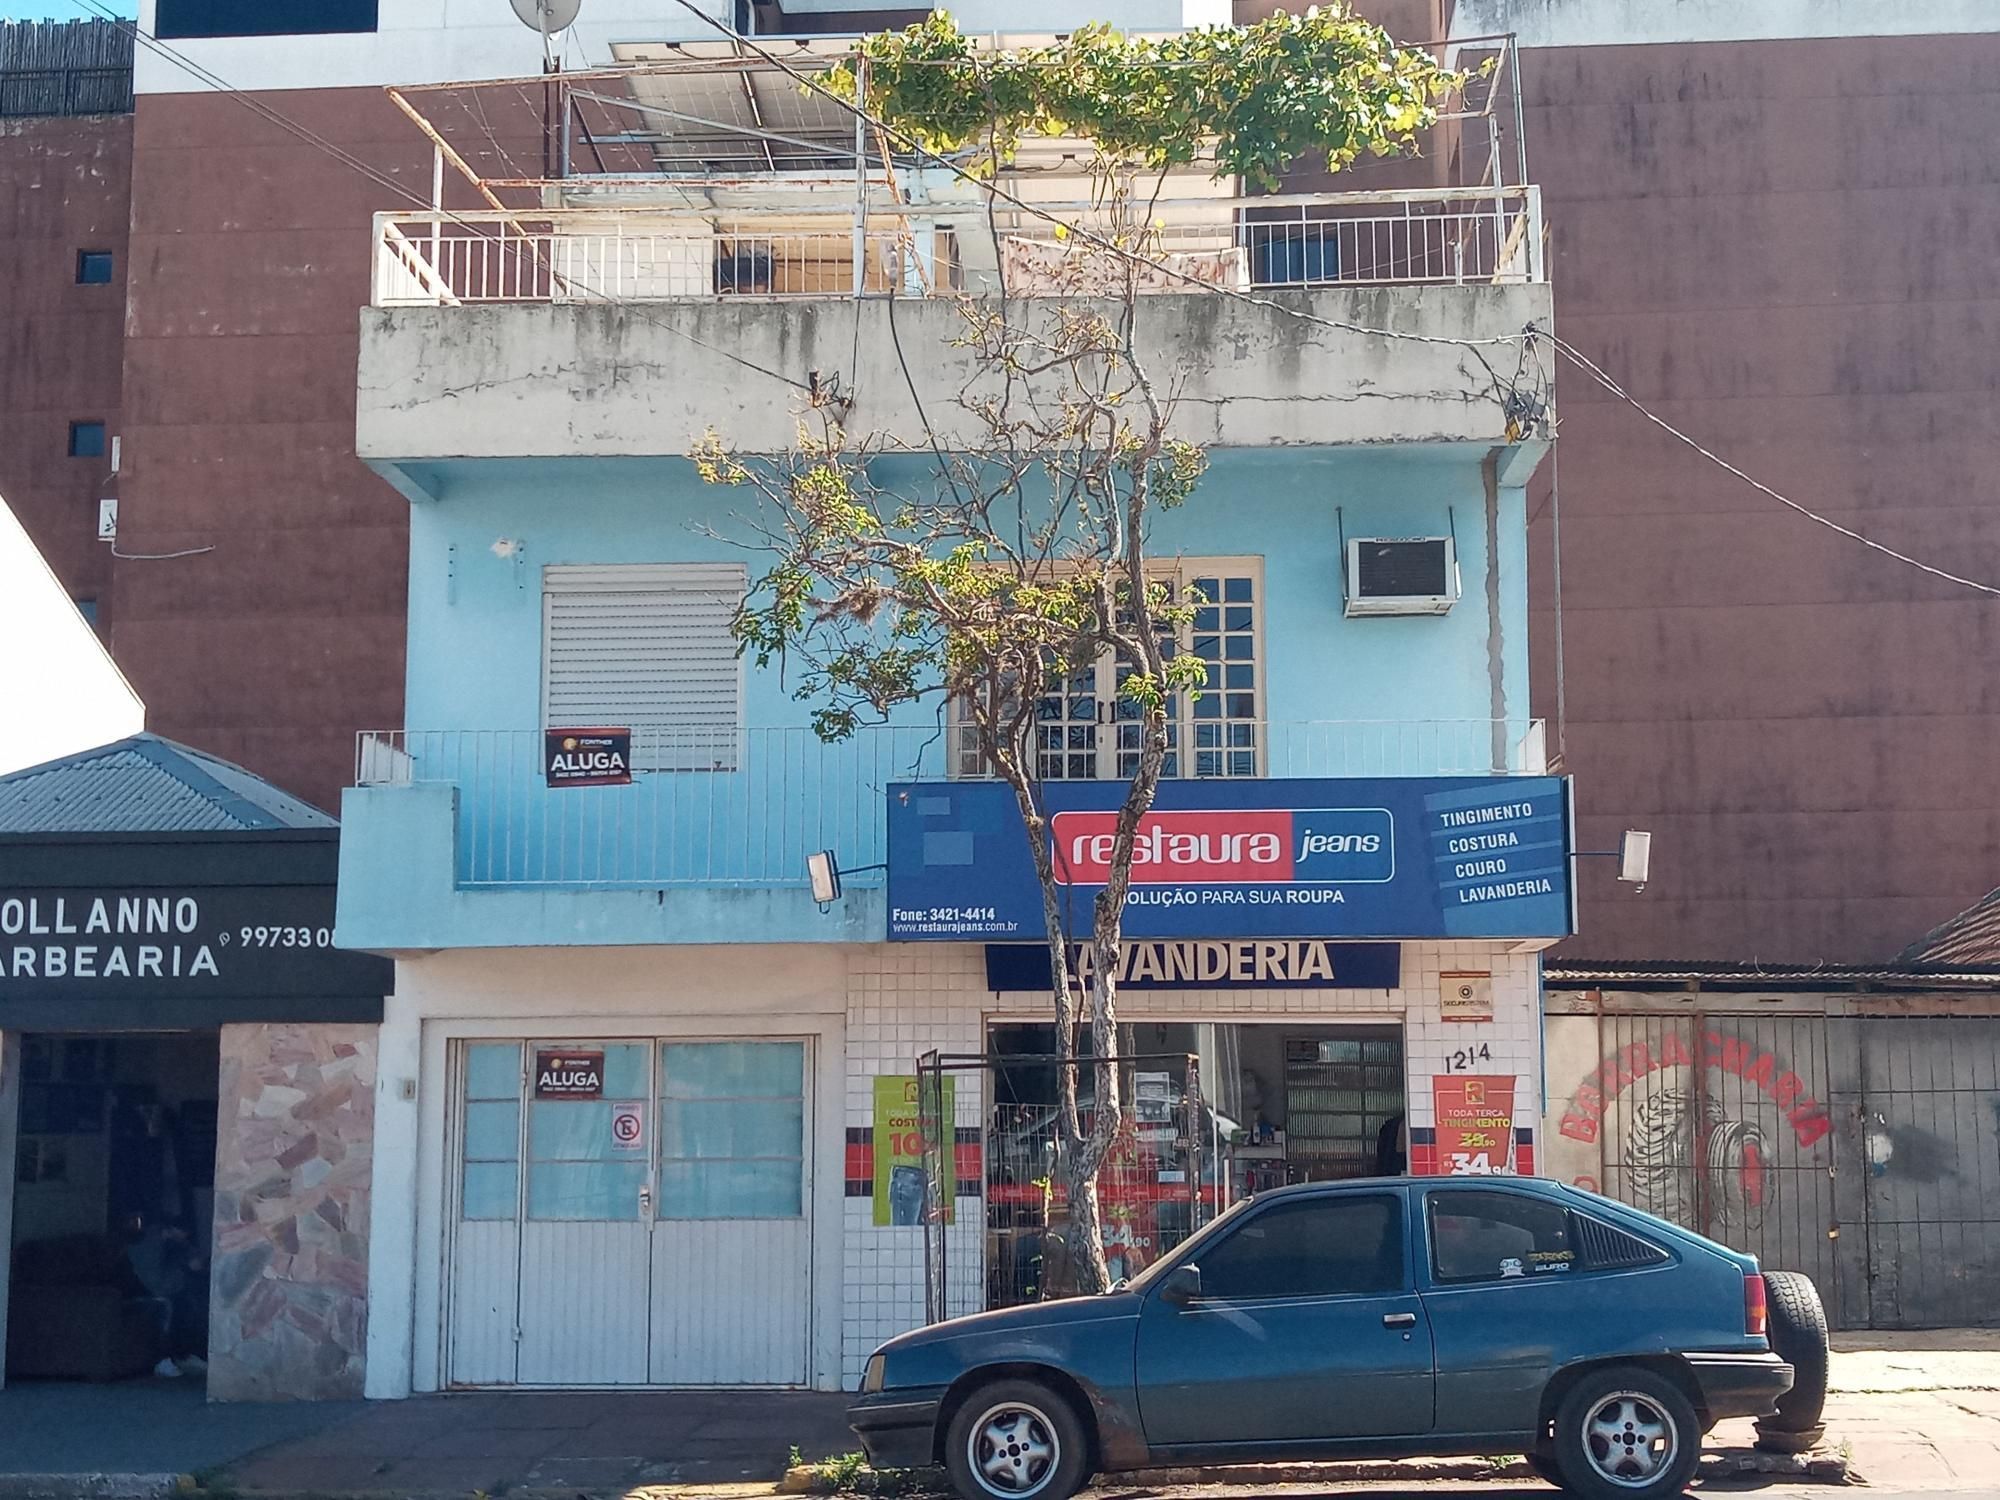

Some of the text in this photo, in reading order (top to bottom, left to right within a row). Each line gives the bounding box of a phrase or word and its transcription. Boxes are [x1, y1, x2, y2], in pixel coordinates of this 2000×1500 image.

[551, 752, 625, 771] ALUGA
[1440, 802, 1532, 828] TINGIMENTO
[1072, 825, 1380, 865] restaura jeans
[1449, 832, 1519, 853] COSTURA
[1455, 859, 1507, 878] COURO
[1126, 887, 1345, 908] OLUÇÃO PARA SUA ROUPA
[1459, 879, 1552, 903] LAVANDERIA
[893, 907, 995, 921] Fone: 3421-4414
[893, 921, 1018, 934] www.restaurajeans.com.br
[1445, 1042, 1490, 1074] 1214
[539, 1071, 600, 1087] ALUGA
[1442, 1117, 1511, 1128] TINGIMENTO
[1448, 1109, 1473, 1117] TODA
[1535, 1262, 1570, 1272] EURO
